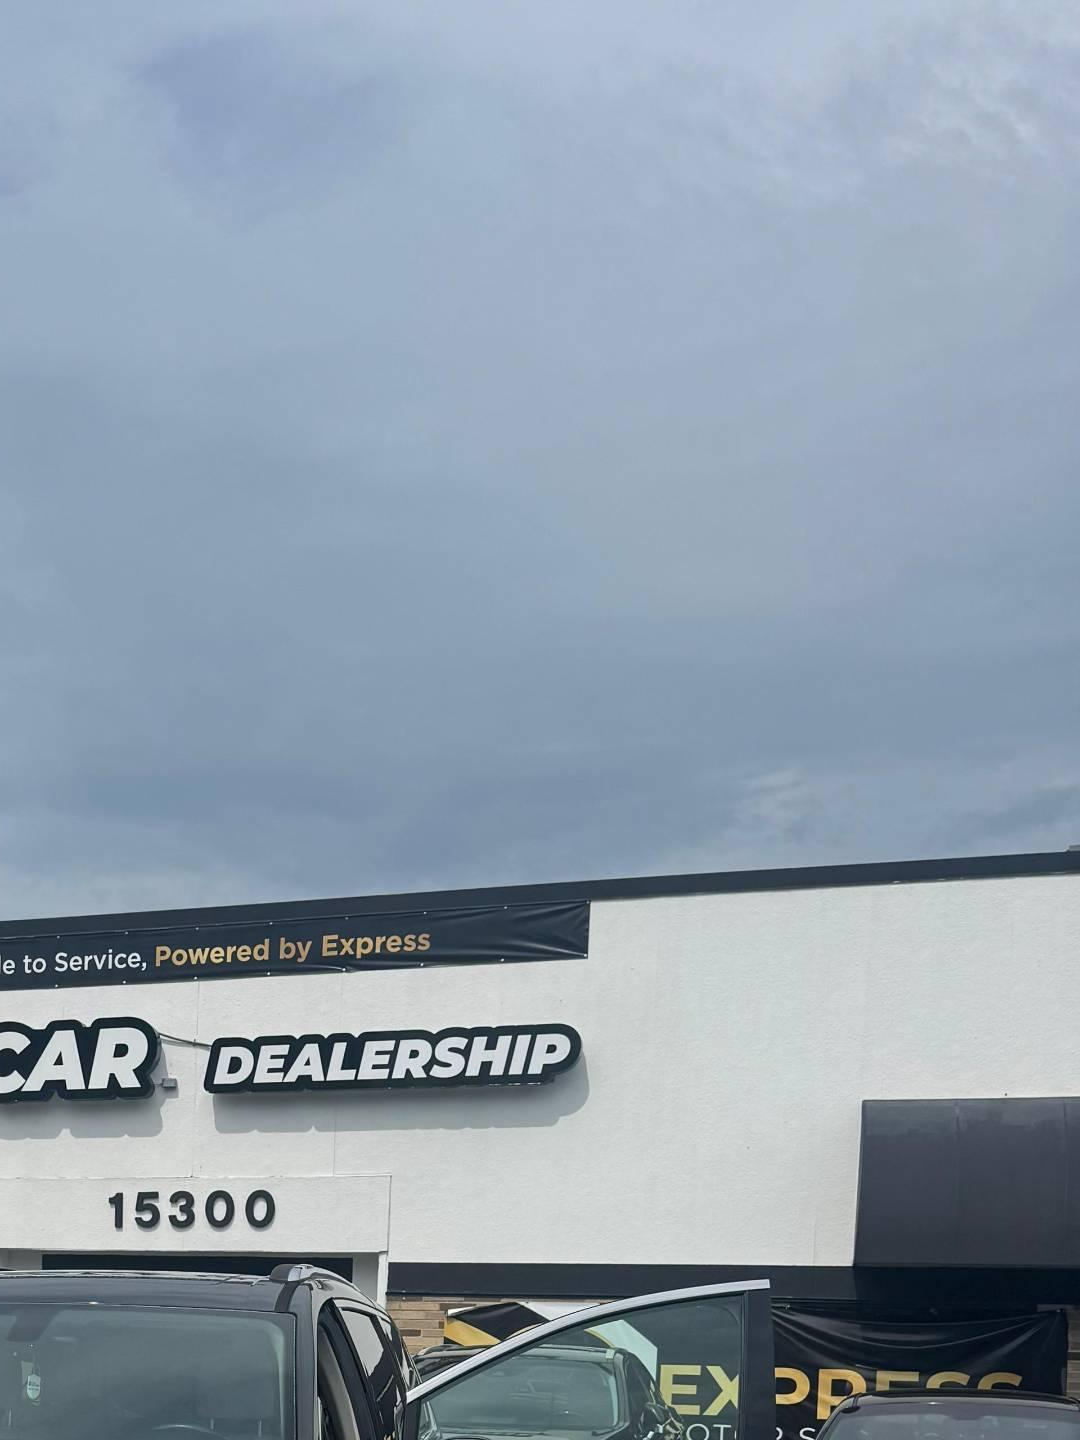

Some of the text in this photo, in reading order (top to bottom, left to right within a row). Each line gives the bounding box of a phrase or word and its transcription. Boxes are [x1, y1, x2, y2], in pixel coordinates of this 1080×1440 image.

[23, 954, 47, 974] to
[54, 949, 147, 972] Service,
[155, 938, 270, 967] Powered
[279, 936, 313, 963] by
[321, 932, 431, 959] Express
[213, 1033, 571, 1085] DEALERSHIP
[108, 1189, 276, 1229] 15300
